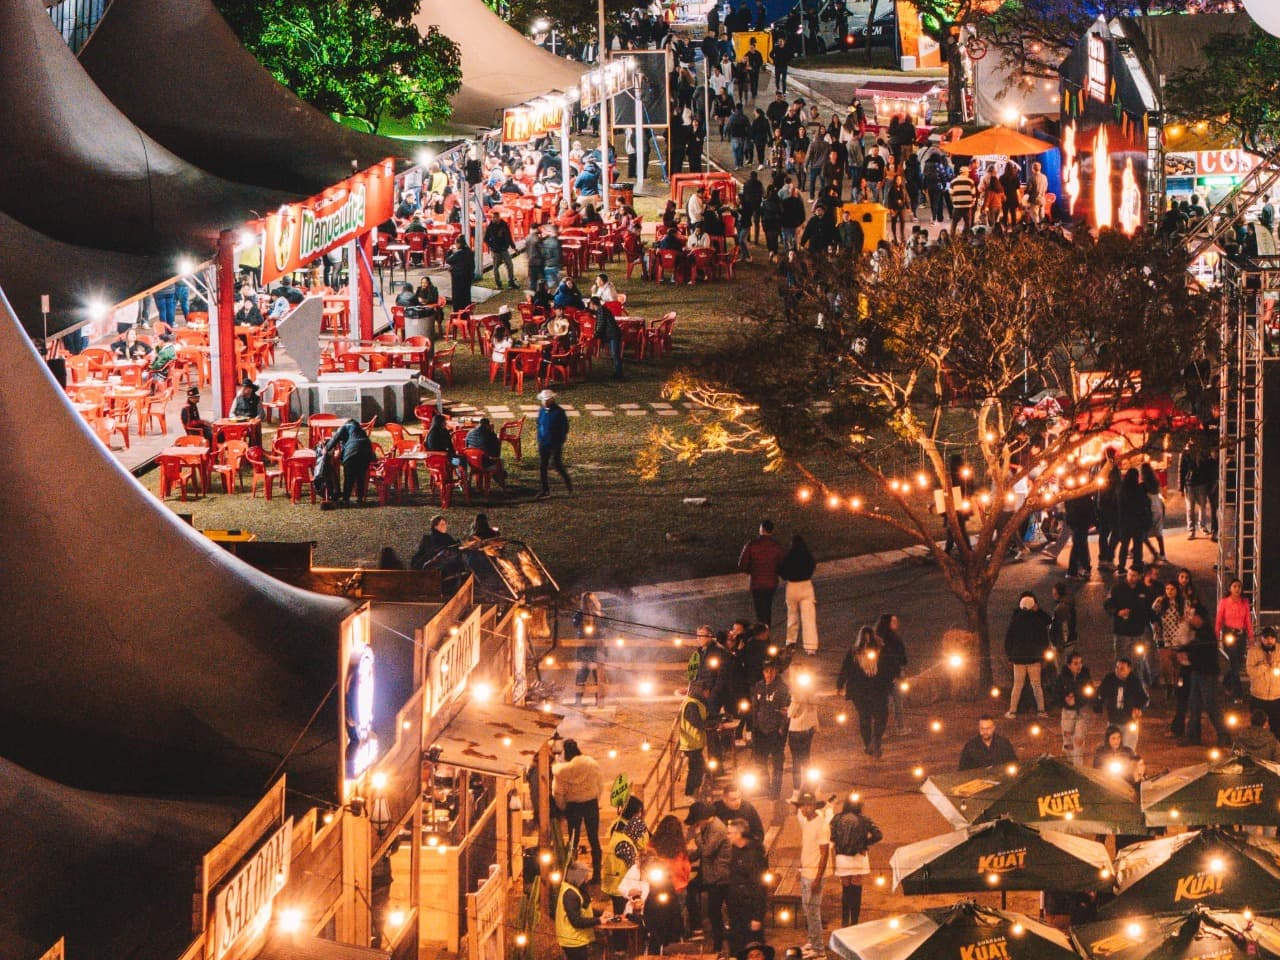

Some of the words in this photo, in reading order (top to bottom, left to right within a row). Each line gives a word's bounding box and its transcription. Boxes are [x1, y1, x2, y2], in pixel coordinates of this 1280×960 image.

[1037, 794, 1083, 817] KUAT
[1216, 787, 1264, 808] KUAT
[978, 851, 1027, 874] KUAT
[1175, 874, 1223, 902] KUAT
[960, 942, 1010, 960] KUAT
